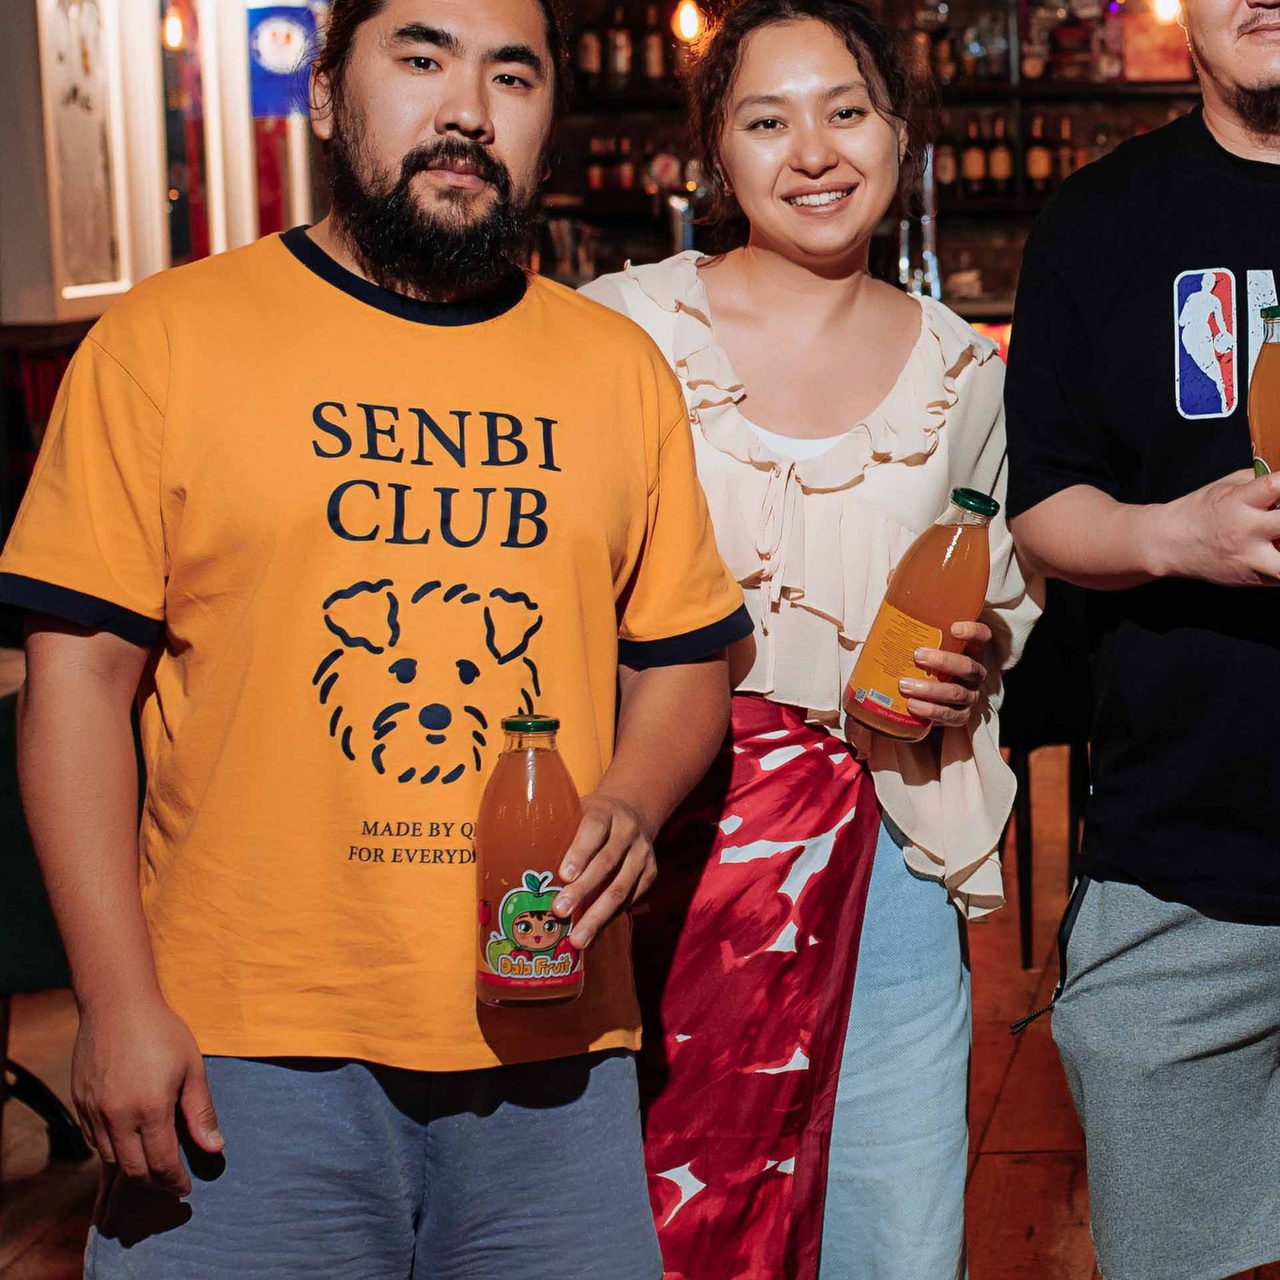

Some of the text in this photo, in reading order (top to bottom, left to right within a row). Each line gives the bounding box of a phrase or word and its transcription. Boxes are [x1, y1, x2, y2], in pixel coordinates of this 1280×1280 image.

[312, 401, 562, 472] SENBI
[327, 479, 549, 549] CLUB
[361, 821, 477, 840] MADE BY Q
[348, 846, 385, 863] FOR
[499, 954, 572, 977] Dala Fruit
